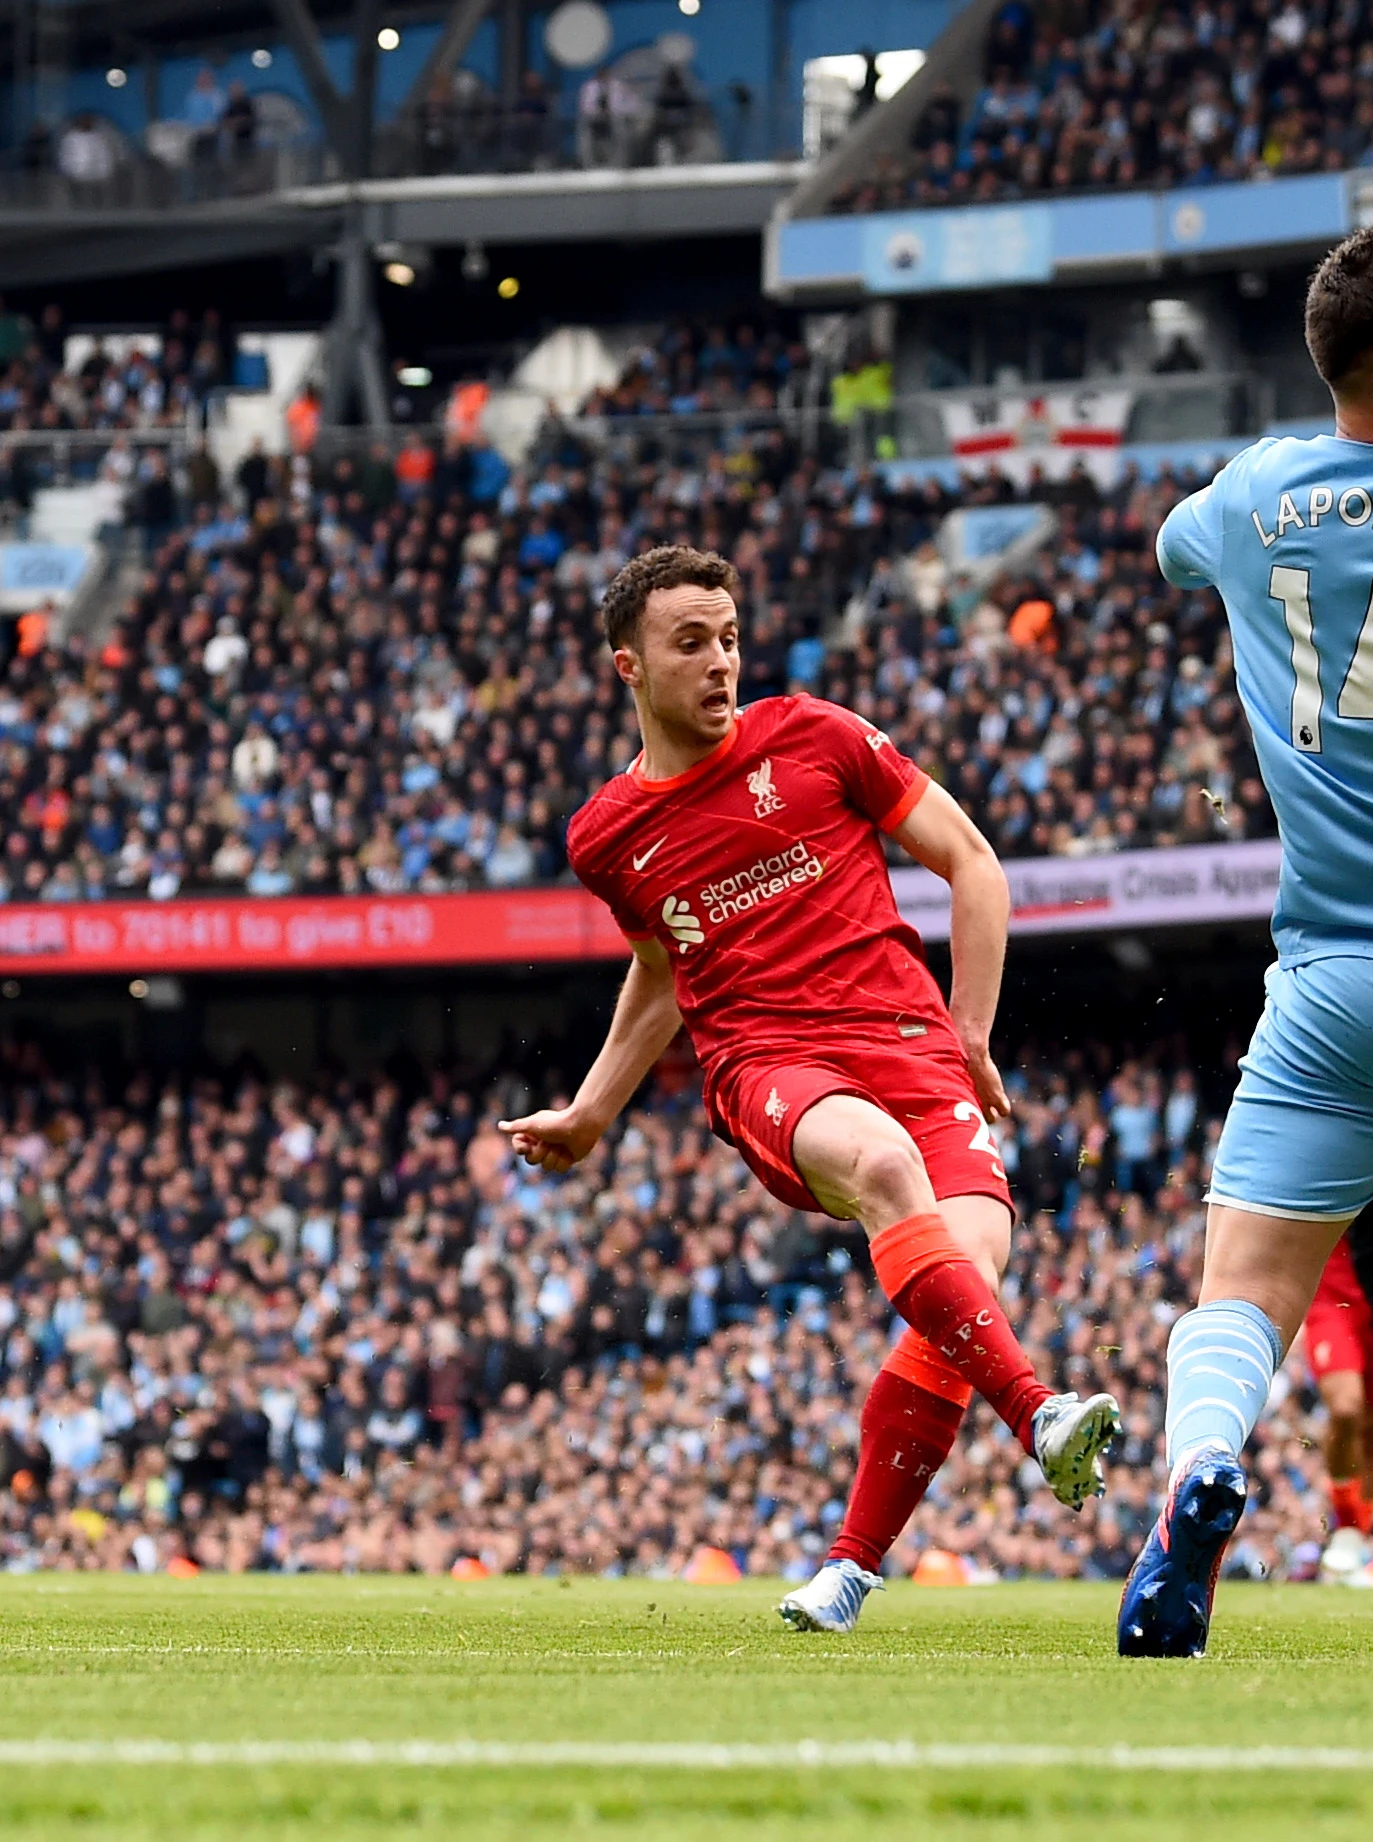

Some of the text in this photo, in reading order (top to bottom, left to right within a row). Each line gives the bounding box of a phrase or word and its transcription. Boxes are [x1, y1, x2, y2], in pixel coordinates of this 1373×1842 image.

[700, 840, 809, 907] standard
[709, 855, 822, 923] chartered
[74, 913, 117, 953] to
[121, 909, 230, 951] 70141
[238, 908, 282, 951] to
[287, 906, 363, 958] give
[367, 904, 434, 948] £10
